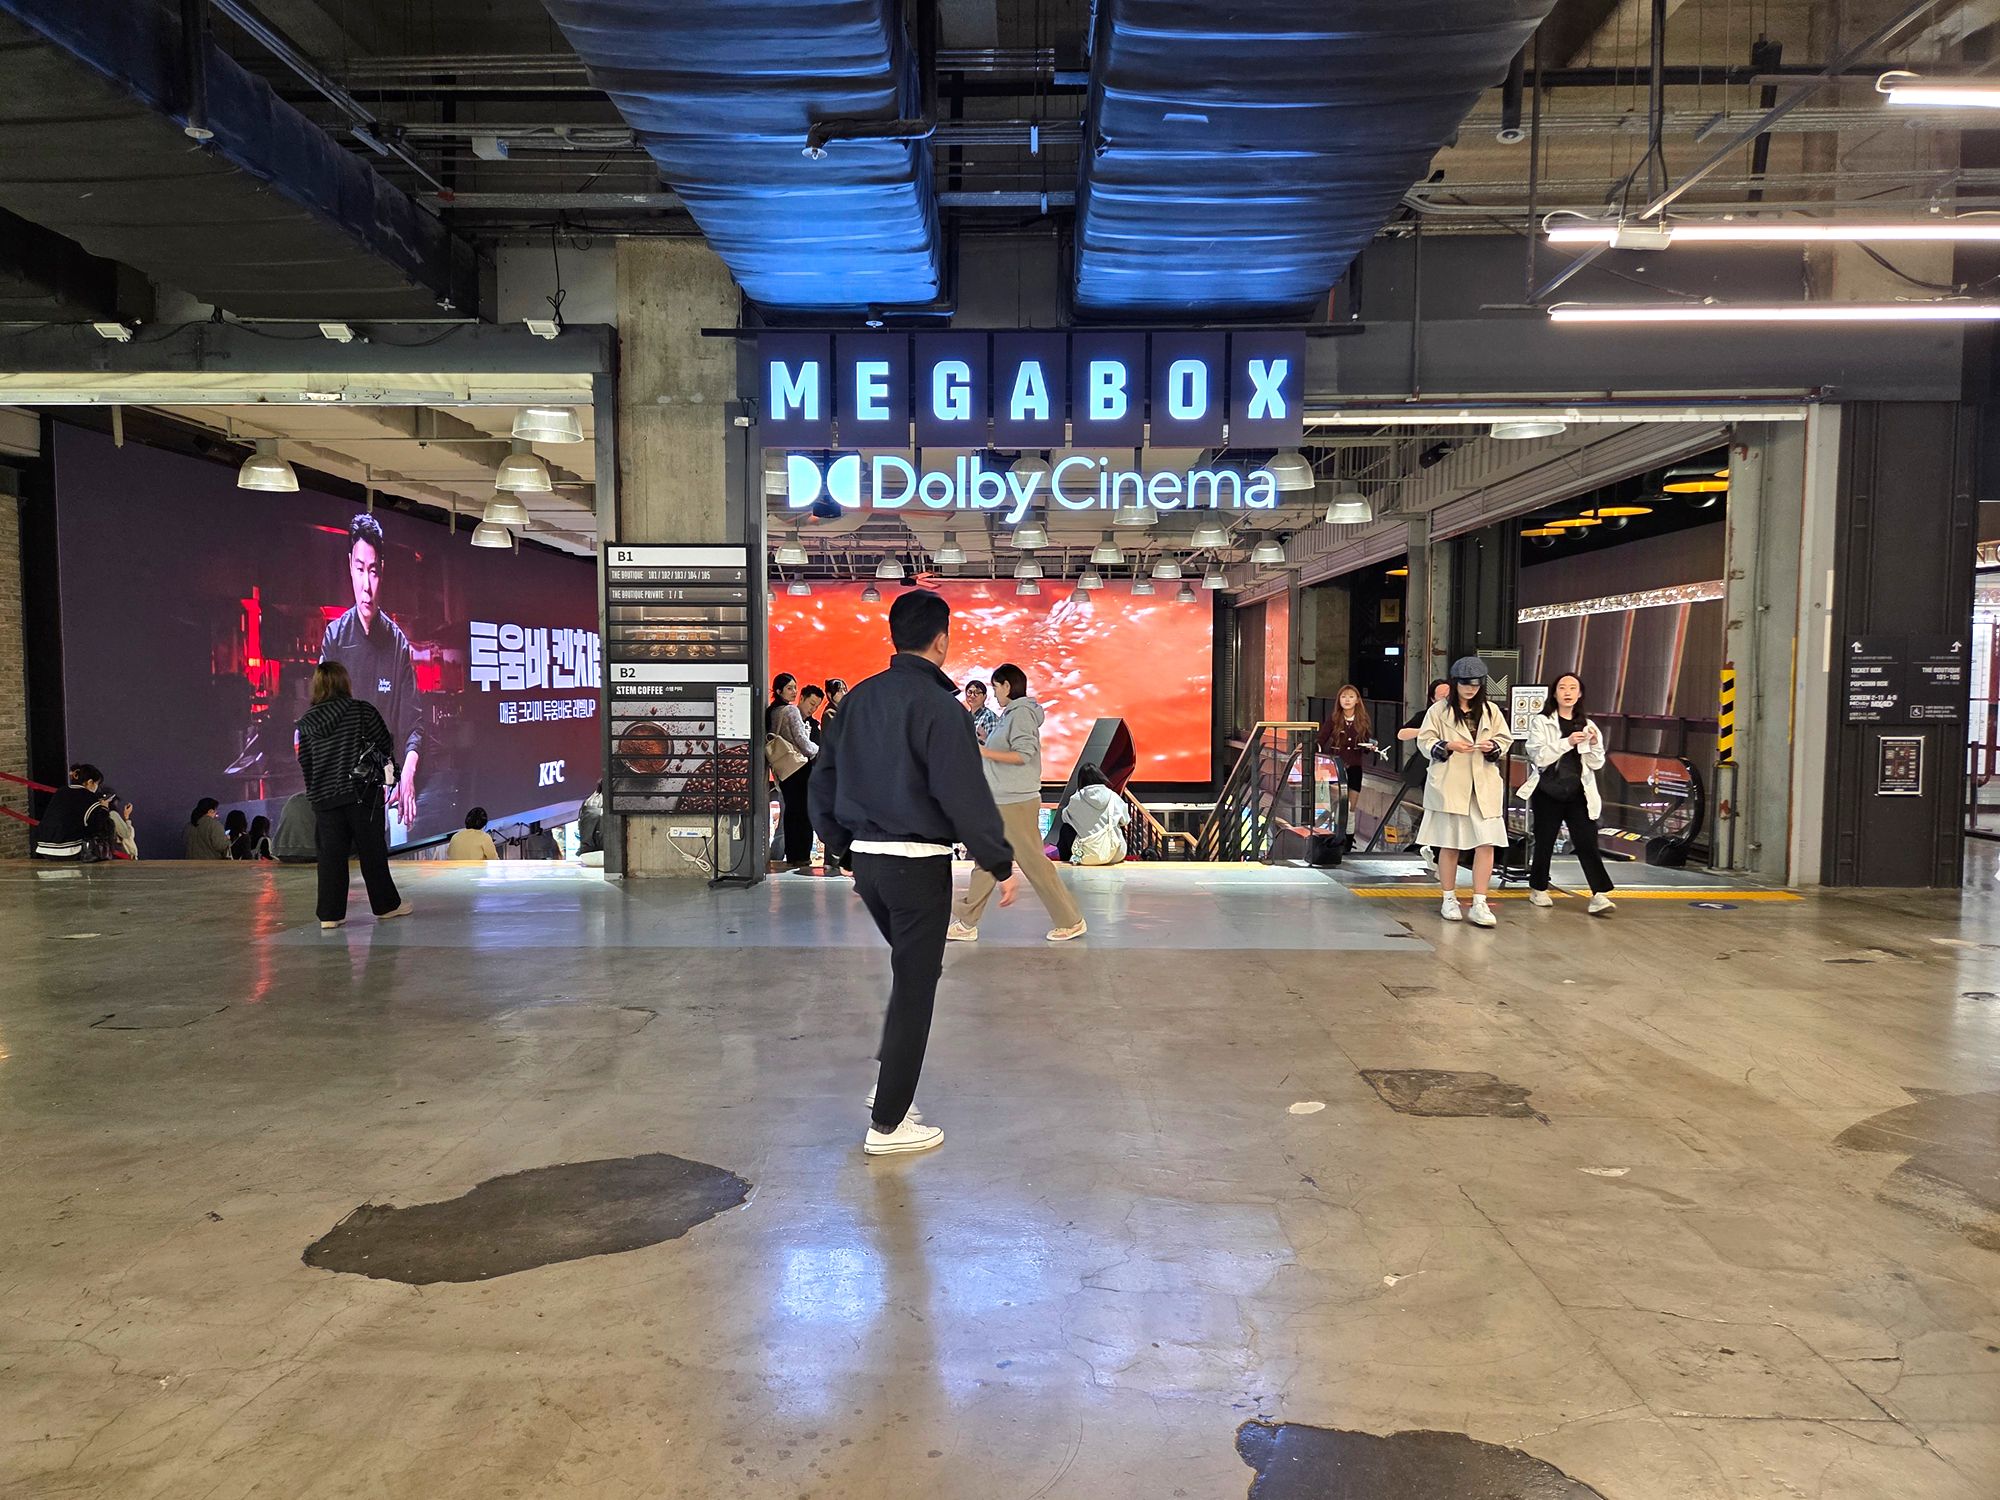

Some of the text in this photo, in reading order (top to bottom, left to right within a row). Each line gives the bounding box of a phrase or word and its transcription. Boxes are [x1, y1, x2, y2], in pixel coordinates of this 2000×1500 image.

[769, 358, 1289, 422] MEGABOX
[872, 455, 1278, 524] Dolby Cinema
[617, 551, 634, 562] B1
[611, 570, 621, 580] THE
[621, 570, 644, 580] BOUTIQUE
[612, 590, 621, 599] THE
[621, 590, 644, 600] BOUTIQUE
[470, 621, 550, 692] 투움바
[620, 667, 636, 678] B2
[616, 685, 664, 695] STEM COFFEE
[499, 702, 518, 724] 매콤
[538, 760, 566, 787] KFC
